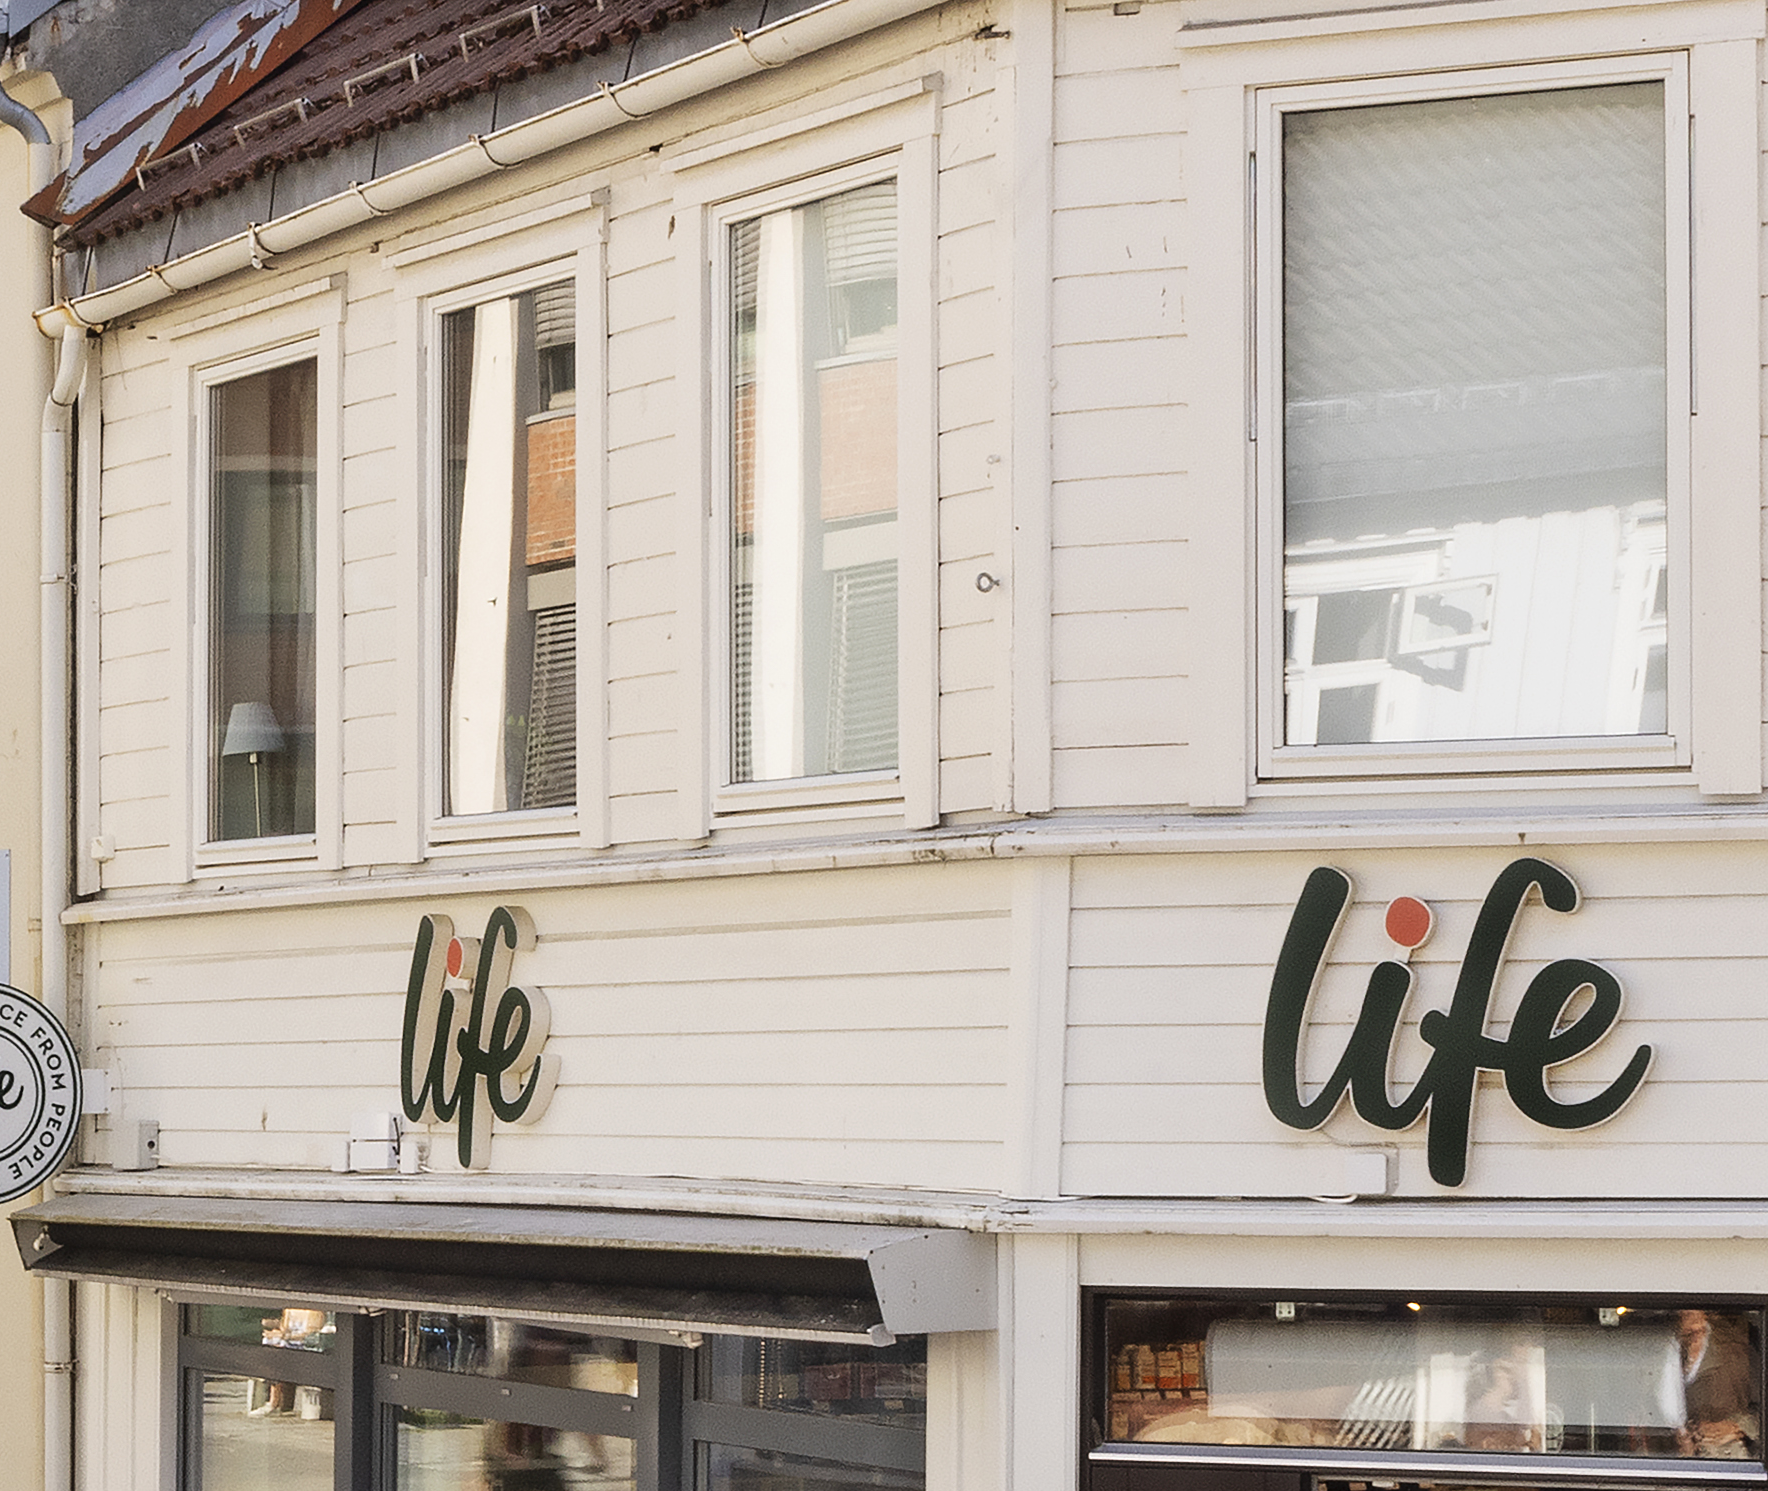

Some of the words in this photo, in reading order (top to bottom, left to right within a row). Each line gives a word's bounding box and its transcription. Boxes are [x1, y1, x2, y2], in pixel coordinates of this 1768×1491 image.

[30, 1026, 67, 1092] FROM
[401, 906, 547, 1169] life
[1263, 857, 1655, 1188] life
[8, 1103, 66, 1180] PEOPLE
